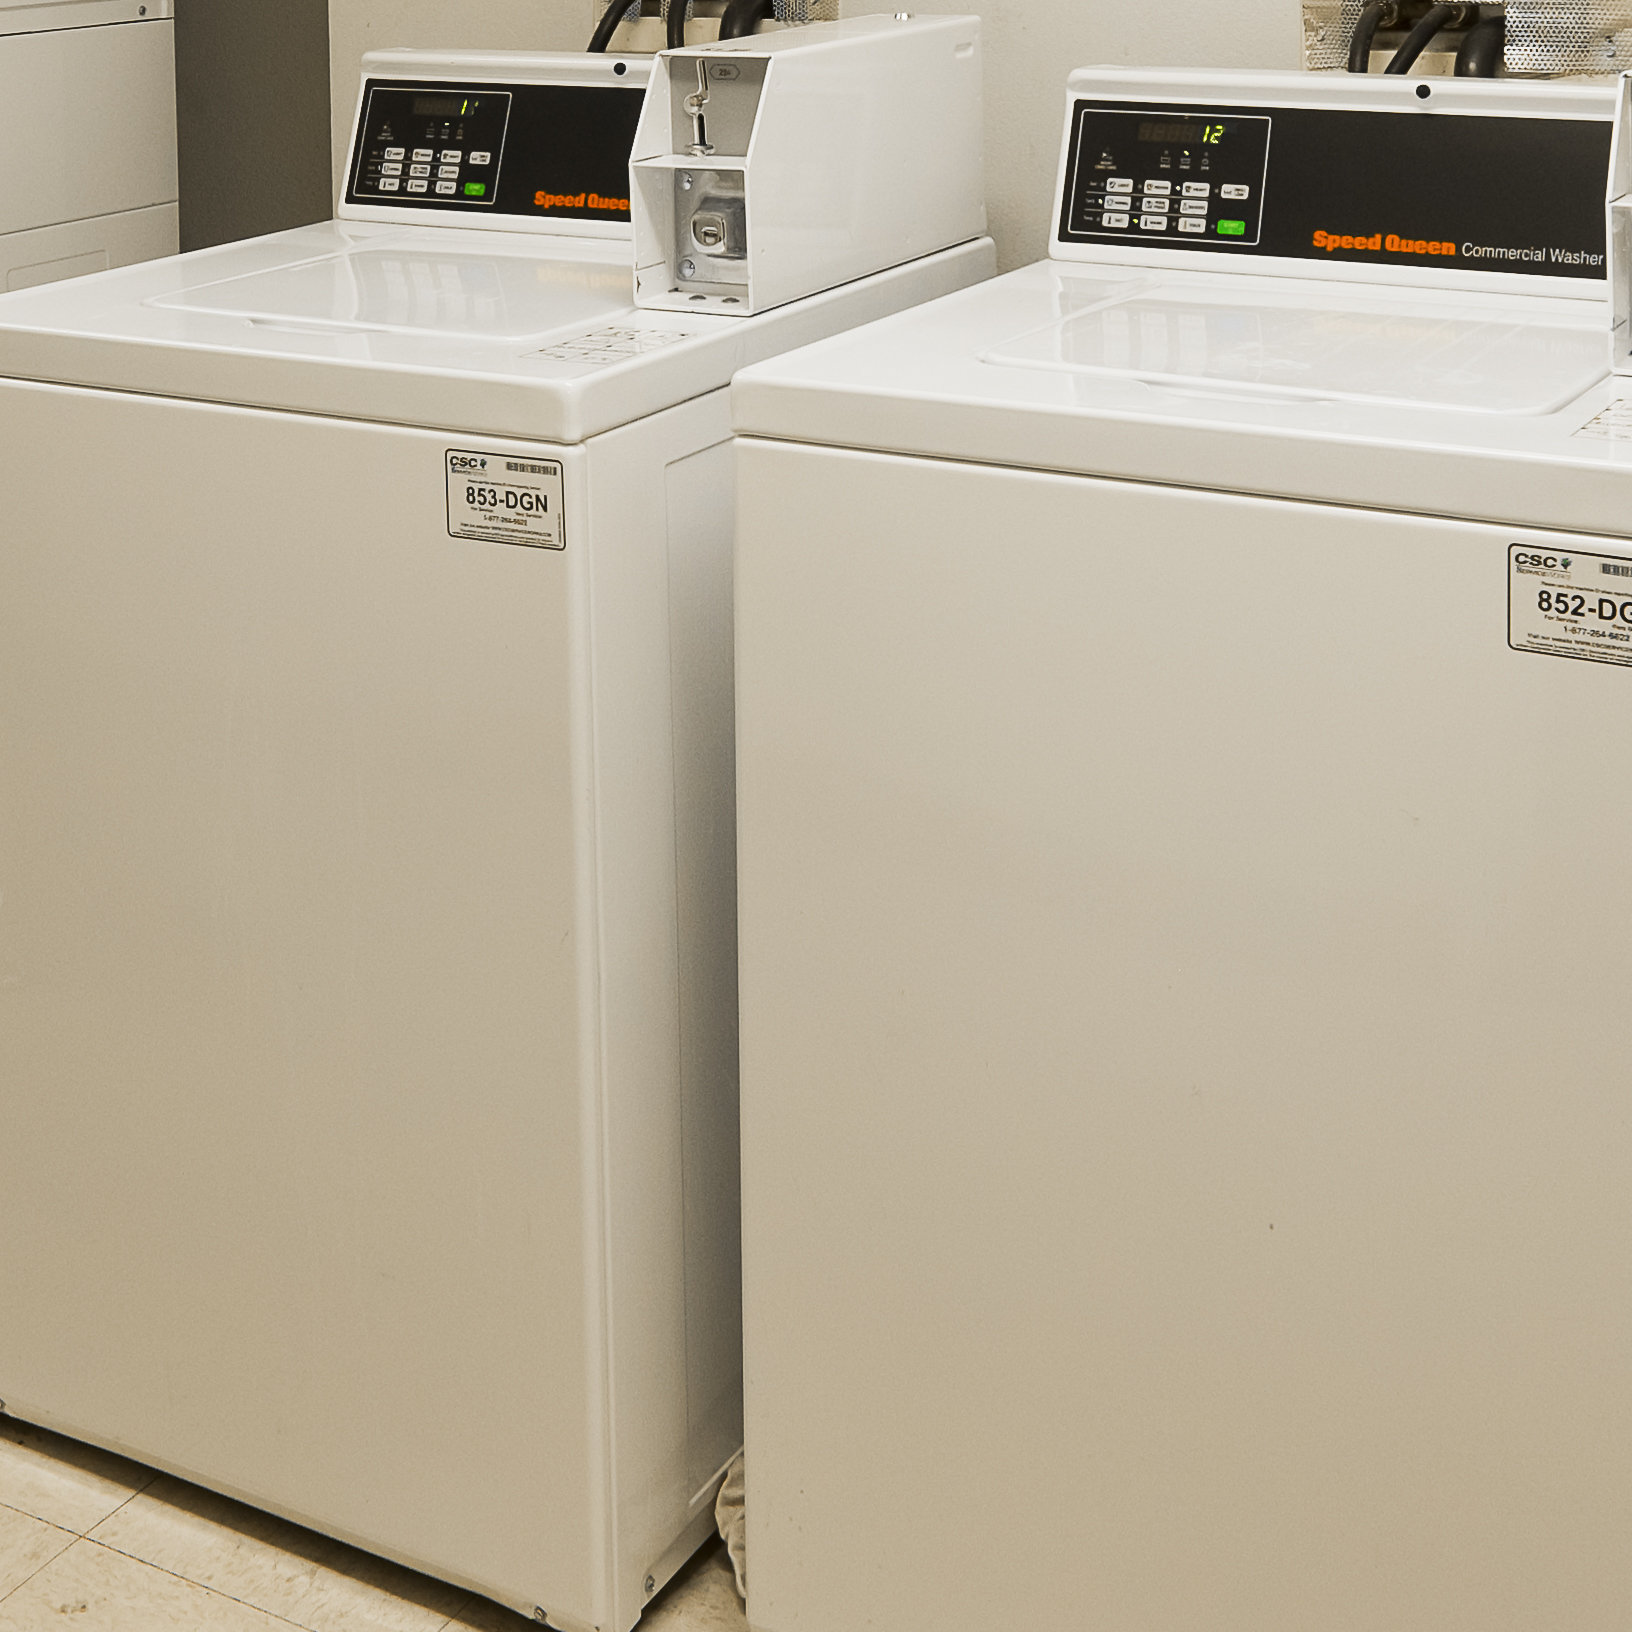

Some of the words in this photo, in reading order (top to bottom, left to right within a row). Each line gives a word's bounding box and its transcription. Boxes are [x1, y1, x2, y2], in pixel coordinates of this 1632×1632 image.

[1202, 125, 1225, 144] 12
[534, 190, 586, 209] Speed
[588, 193, 631, 211] Quee
[1313, 230, 1382, 252] Speed
[1385, 234, 1456, 256] Queen
[1461, 242, 1546, 262] Commercial
[1550, 248, 1604, 266] Washer
[450, 456, 478, 468] CSC
[466, 486, 548, 513] 853-DGN
[1515, 552, 1558, 569] CSC
